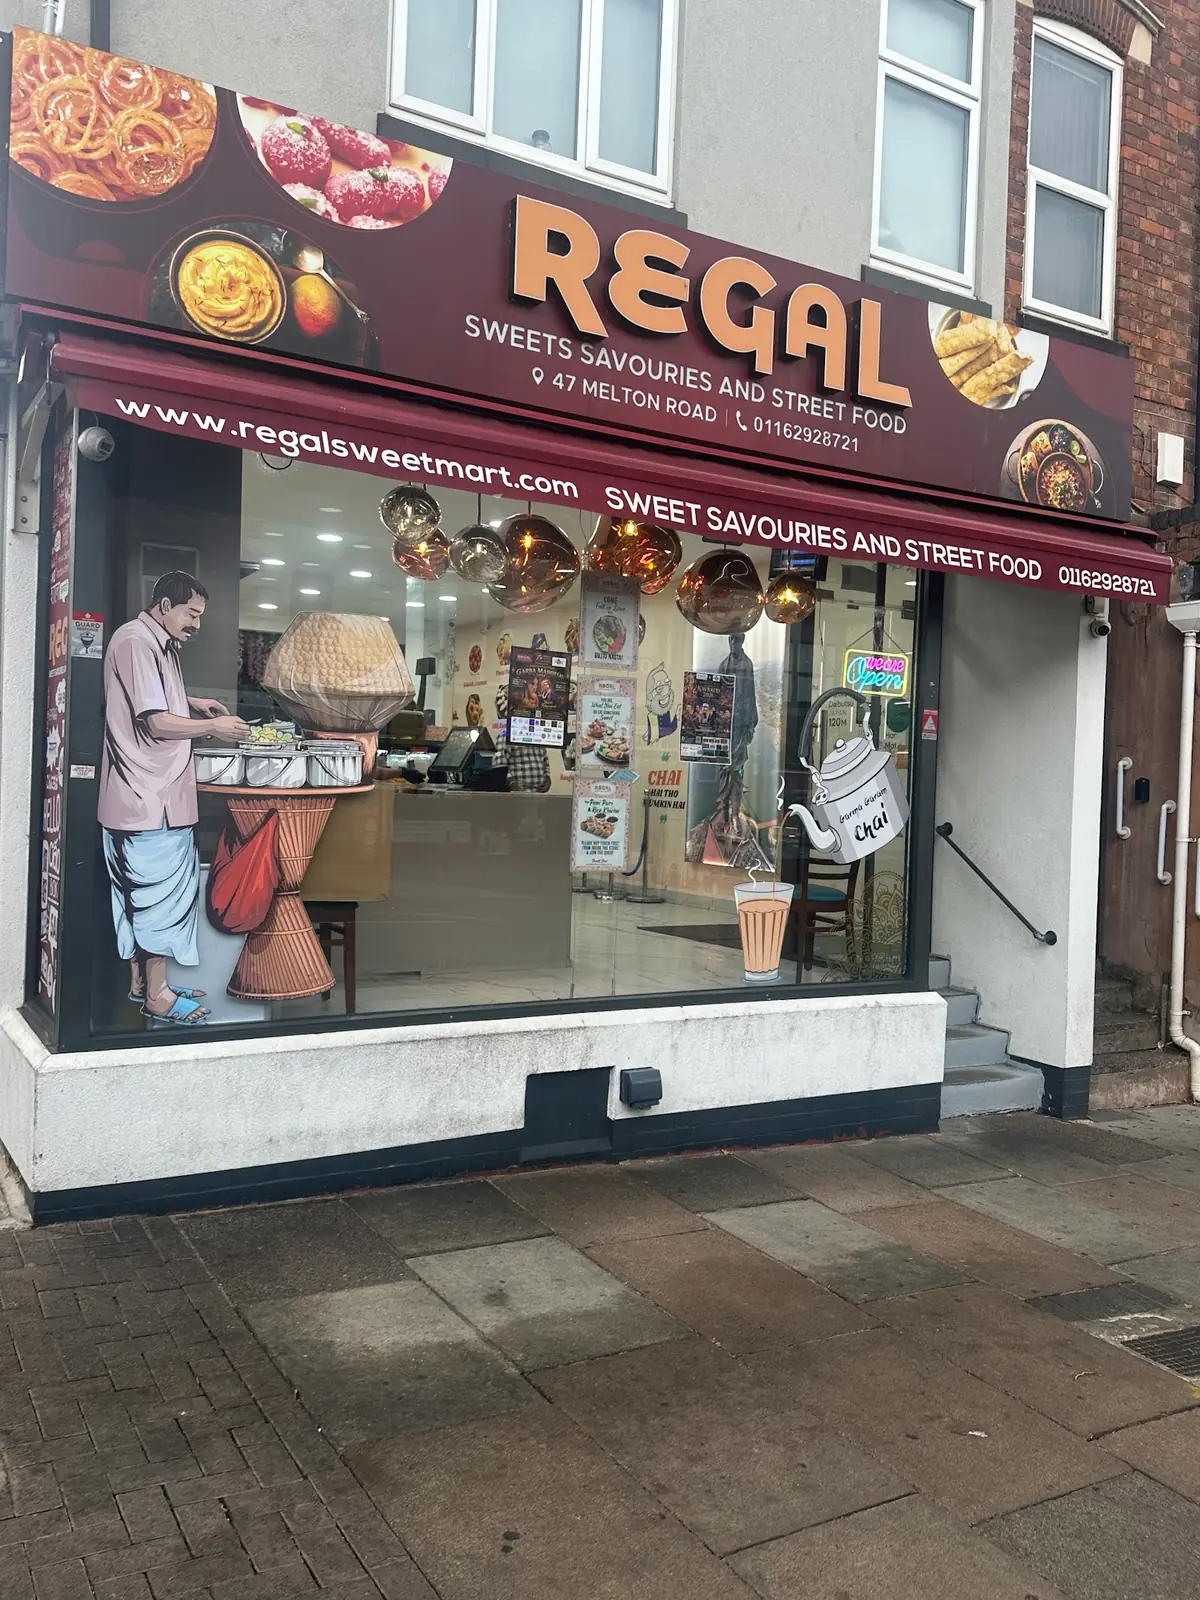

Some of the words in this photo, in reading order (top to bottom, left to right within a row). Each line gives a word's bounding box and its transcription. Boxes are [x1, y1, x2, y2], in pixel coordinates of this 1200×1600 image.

[513, 194, 912, 408] REGAL
[465, 314, 573, 360] SWEETS
[580, 343, 712, 392] SAVOURIES
[718, 376, 765, 403] AND
[771, 387, 846, 422] STREET
[852, 405, 907, 434] FOOD
[552, 372, 577, 392] 47
[582, 378, 660, 411] MELTON
[666, 396, 717, 422] ROAD
[753, 416, 858, 452] 01162928721
[114, 398, 579, 499] www.regalsweetmart.com
[604, 486, 702, 526] SWEET
[706, 506, 848, 551] SAVOURIES
[852, 531, 901, 557] AND
[904, 538, 985, 570] STREET
[988, 551, 1042, 581] FOOD
[1058, 566, 1157, 597] 01162928721
[75, 621, 101, 629] GUARD
[846, 656, 904, 693] Open
[647, 769, 683, 786] CHAI
[663, 789, 679, 798] THO
[672, 801, 686, 810] HAI
[864, 787, 887, 806] Garam
